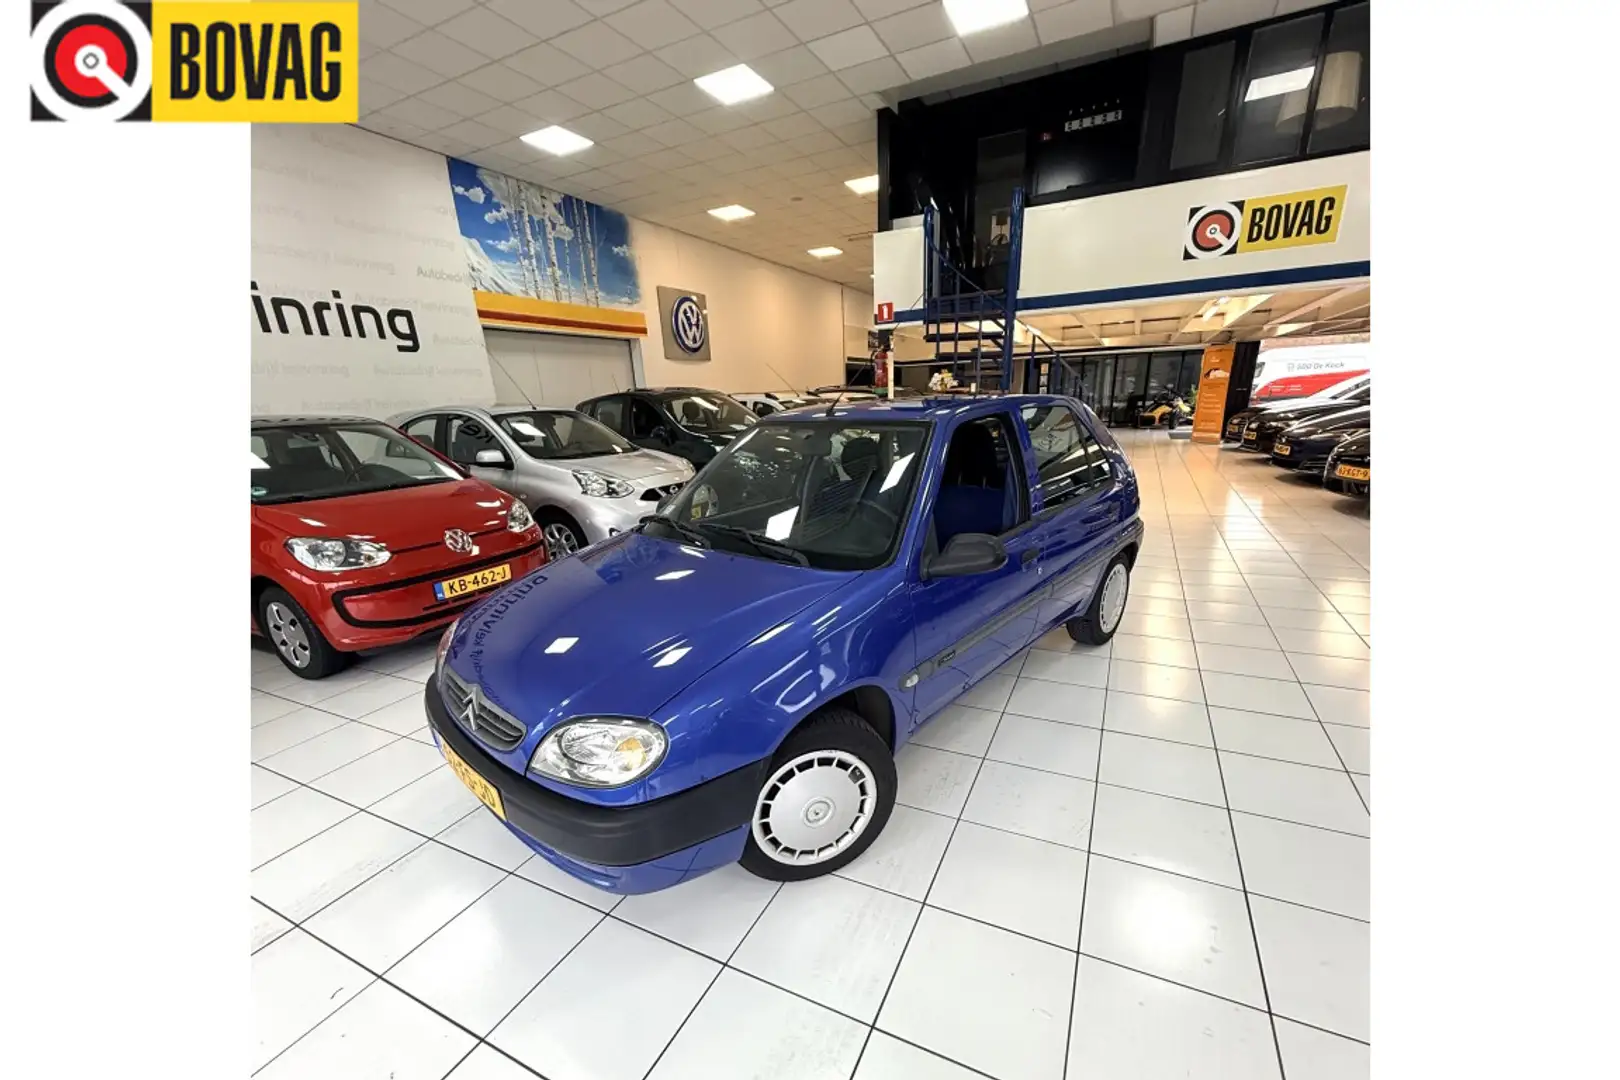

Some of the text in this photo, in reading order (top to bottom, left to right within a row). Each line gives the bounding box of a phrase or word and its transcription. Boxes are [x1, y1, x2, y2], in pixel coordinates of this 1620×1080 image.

[1246, 196, 1336, 243] BOVAG
[251, 280, 420, 353] inring
[448, 567, 506, 595] KB-462-J
